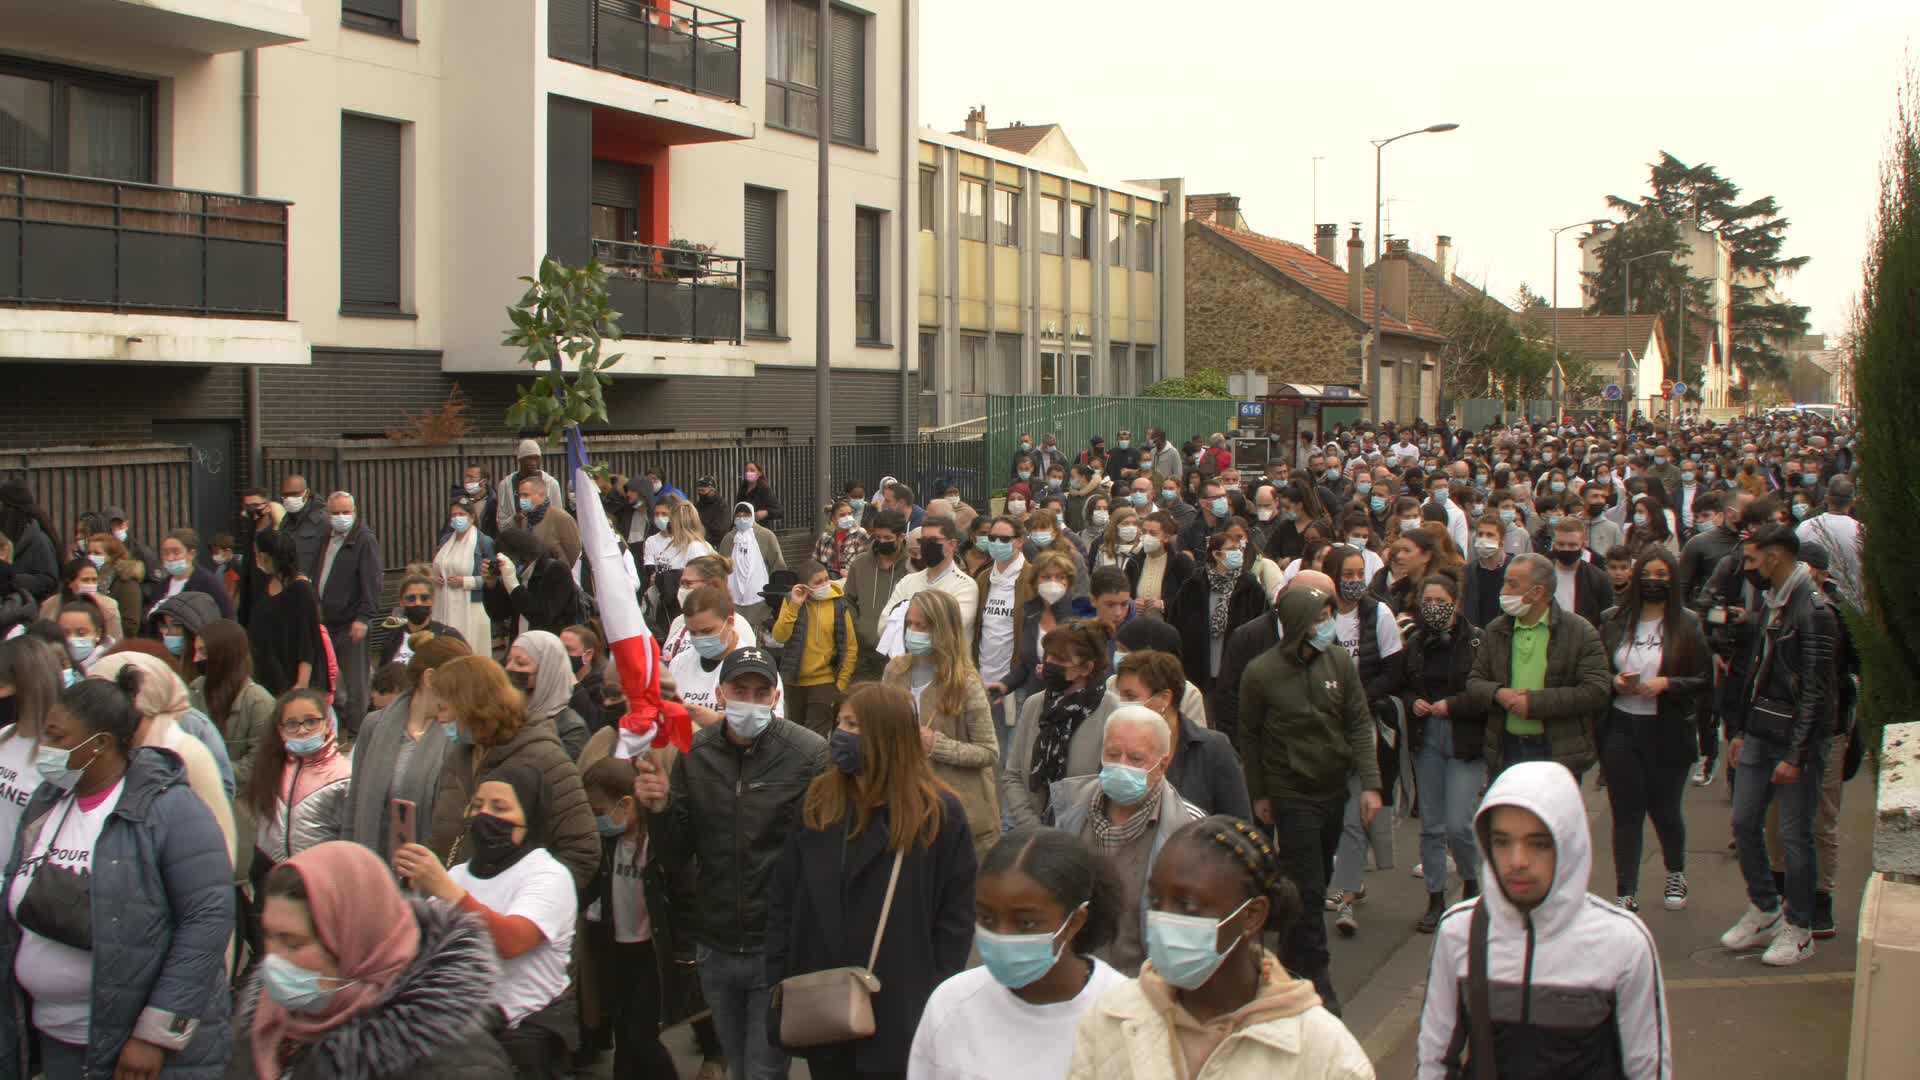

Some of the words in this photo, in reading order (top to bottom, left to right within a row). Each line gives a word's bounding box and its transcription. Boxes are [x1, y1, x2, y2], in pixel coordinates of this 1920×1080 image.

[1241, 404, 1262, 414] 616
[983, 606, 1016, 617] YMANE
[0, 766, 18, 782] OUR
[0, 782, 30, 808] ANE
[50, 848, 89, 862] POUR
